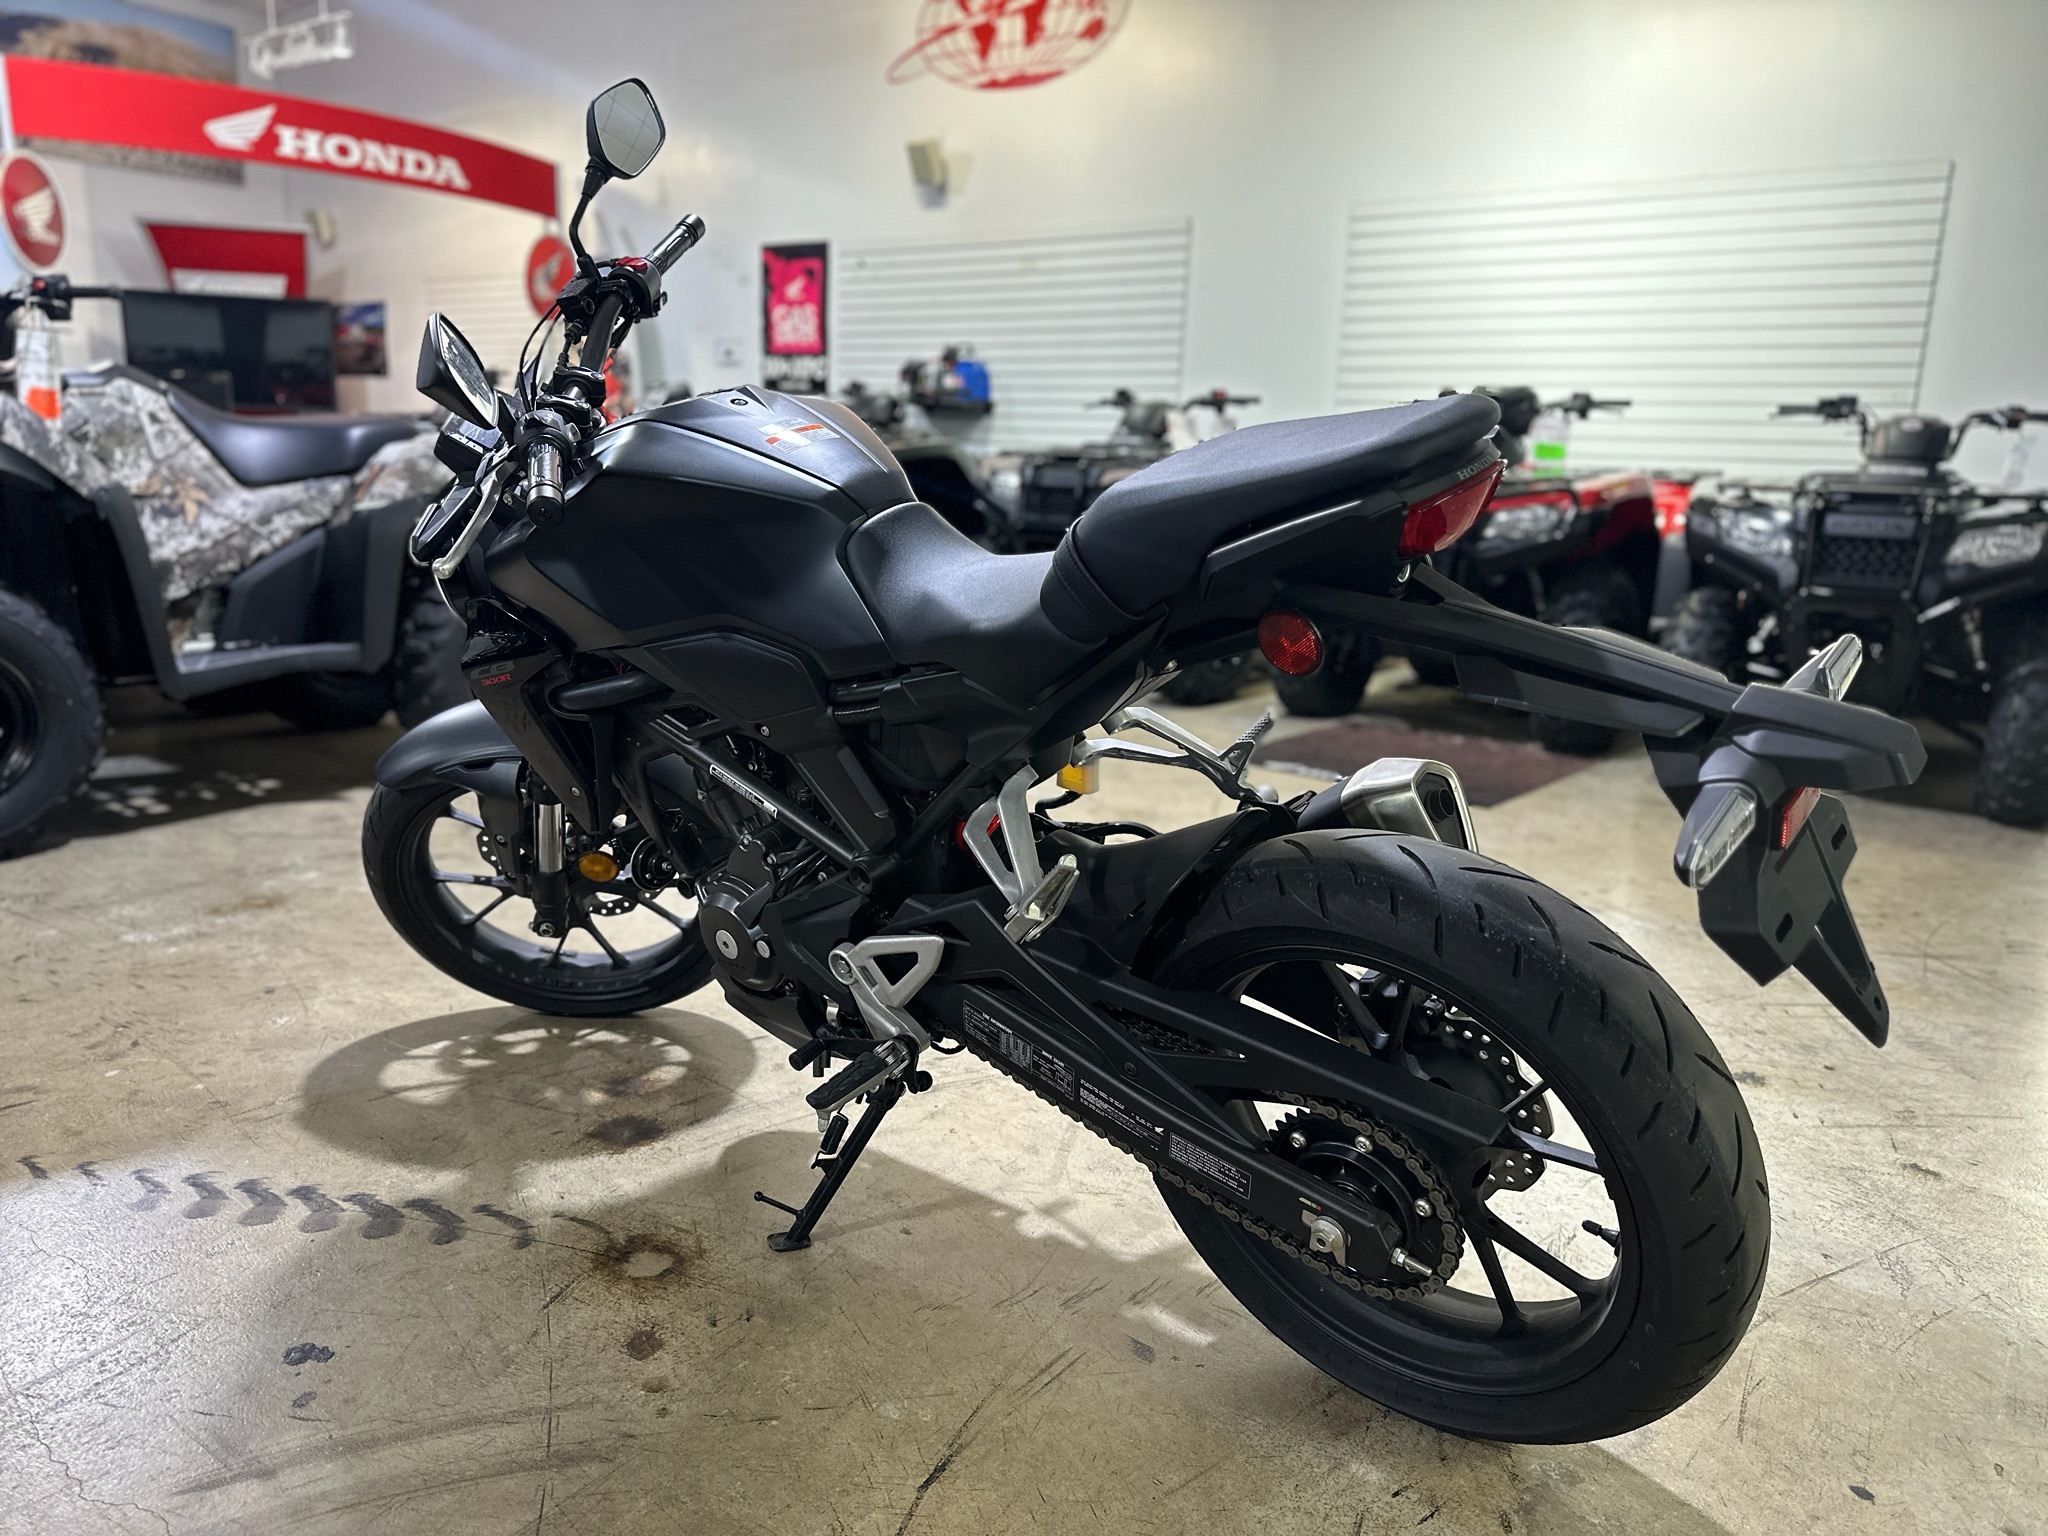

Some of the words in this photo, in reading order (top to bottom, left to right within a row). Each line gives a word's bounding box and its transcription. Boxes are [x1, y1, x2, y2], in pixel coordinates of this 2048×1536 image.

[273, 123, 471, 191] HONDA
[1456, 455, 1495, 480] HONDA
[470, 660, 515, 680] CB
[481, 673, 512, 687] 300R
